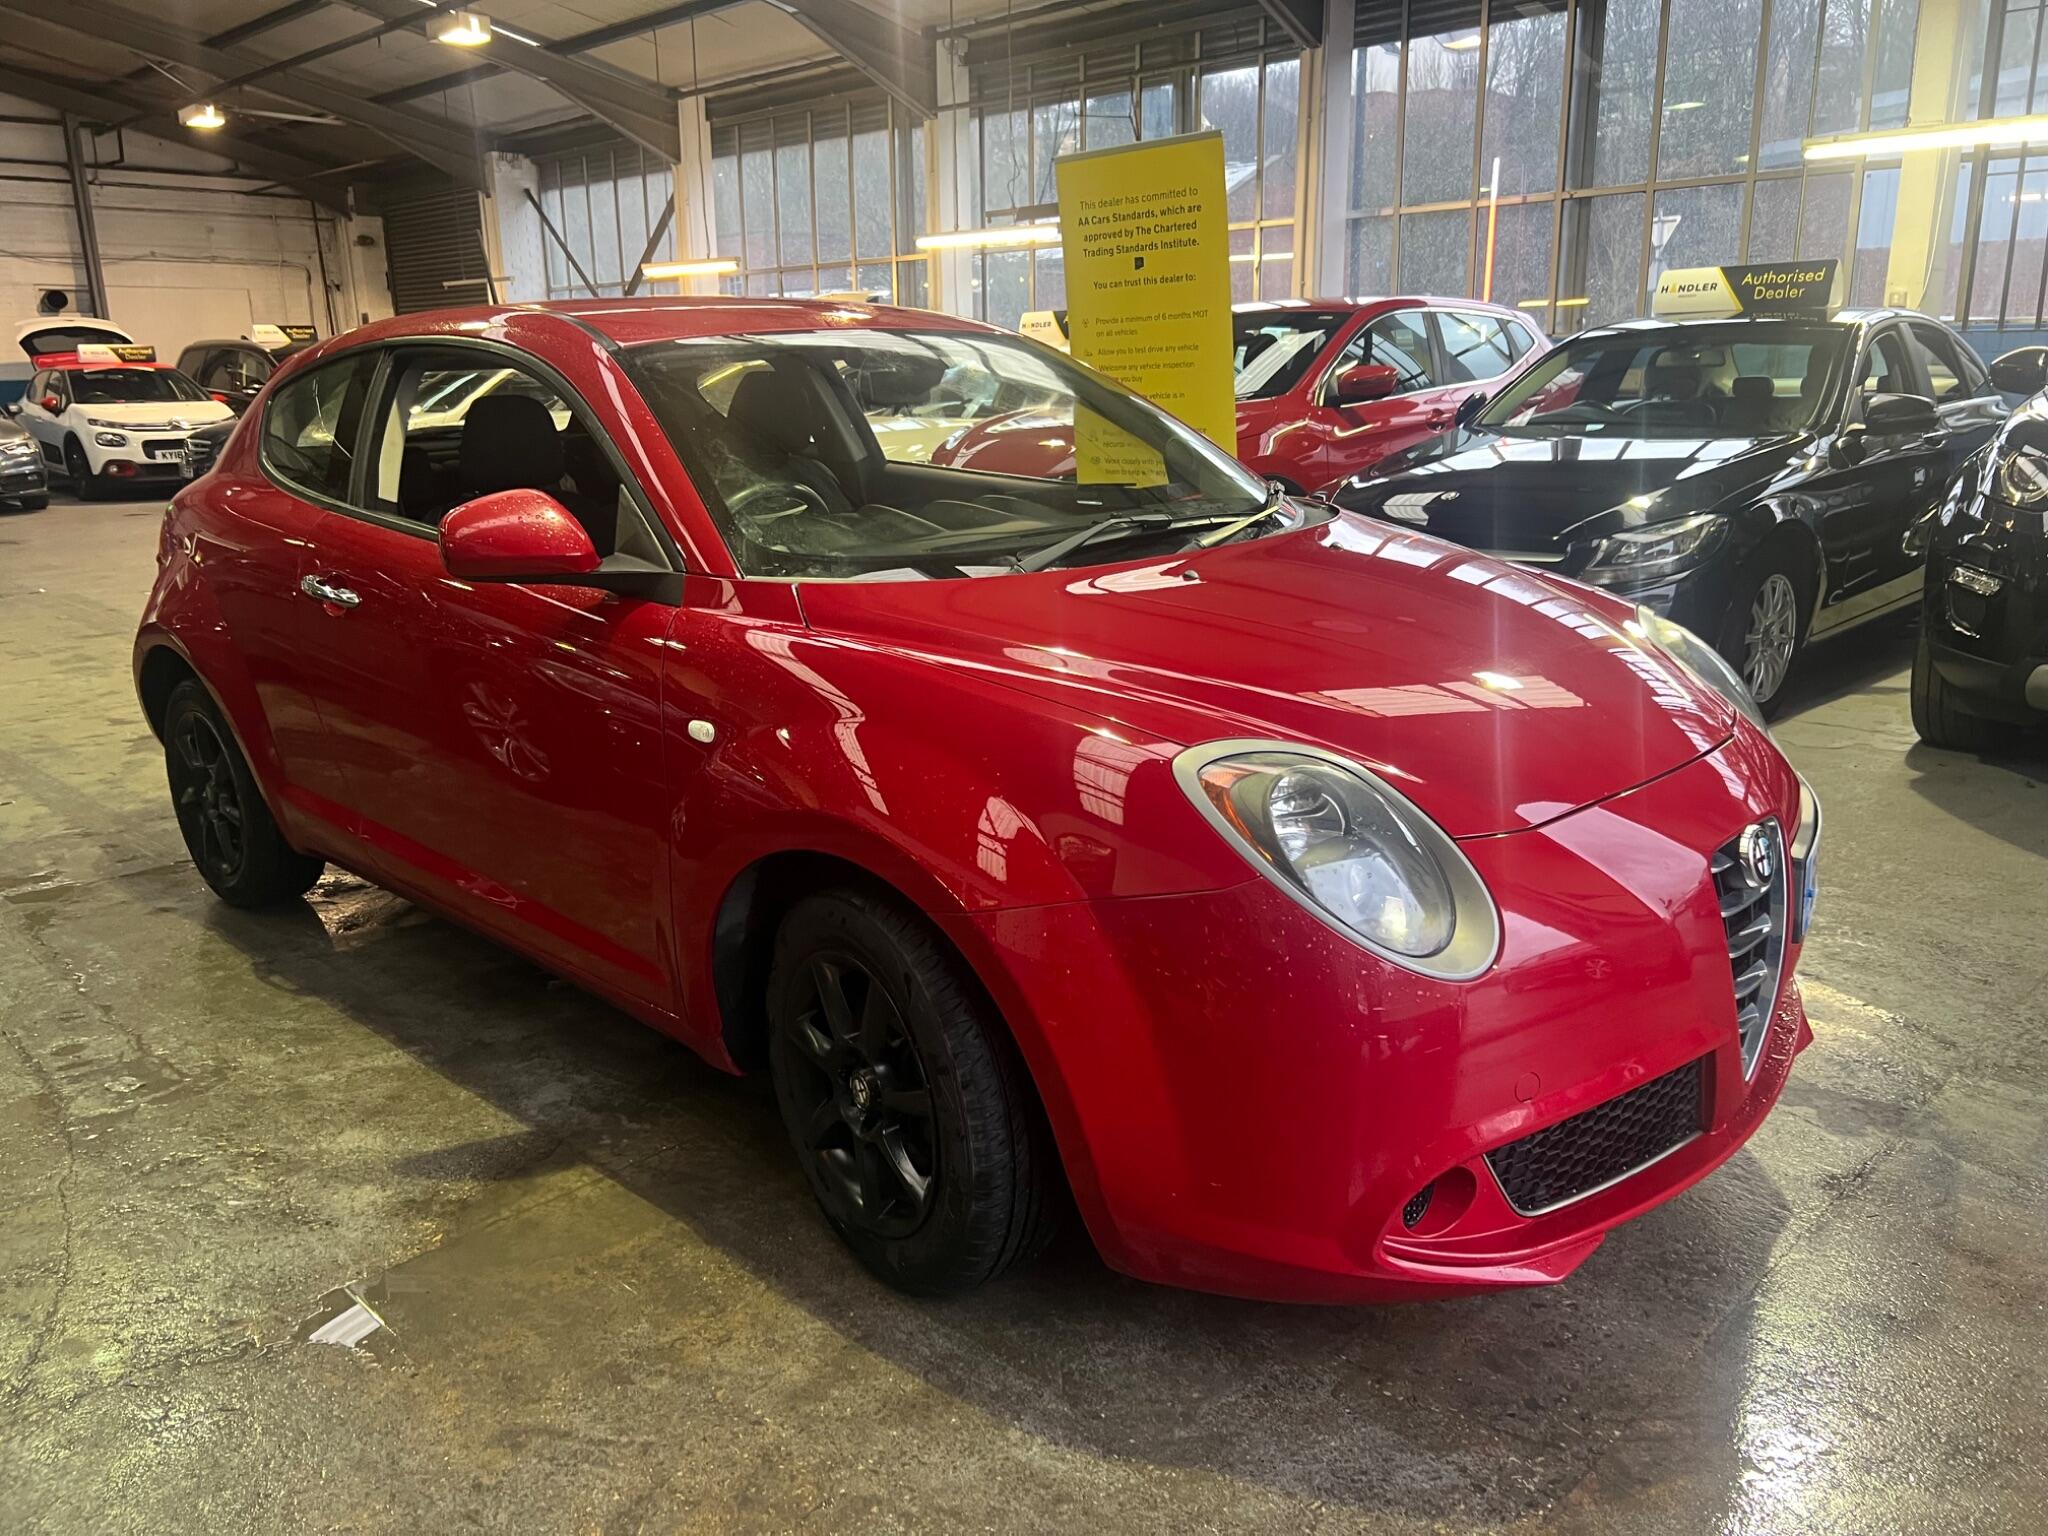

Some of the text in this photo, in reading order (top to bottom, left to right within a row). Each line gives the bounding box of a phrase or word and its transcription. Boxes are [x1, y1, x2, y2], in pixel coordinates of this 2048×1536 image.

[1080, 186, 1198, 211] This dealer has committed to
[1078, 204, 1202, 227] AA Cars Standards, which are
[1083, 220, 1197, 241] approved by The Chartered
[1083, 237, 1199, 258] Trading Standards Institute.
[1093, 273, 1196, 290] You can trust this dealer to:
[1742, 267, 1826, 285] Authorised
[1661, 283, 1717, 293] HANDLER
[1754, 286, 1805, 300] Dealer
